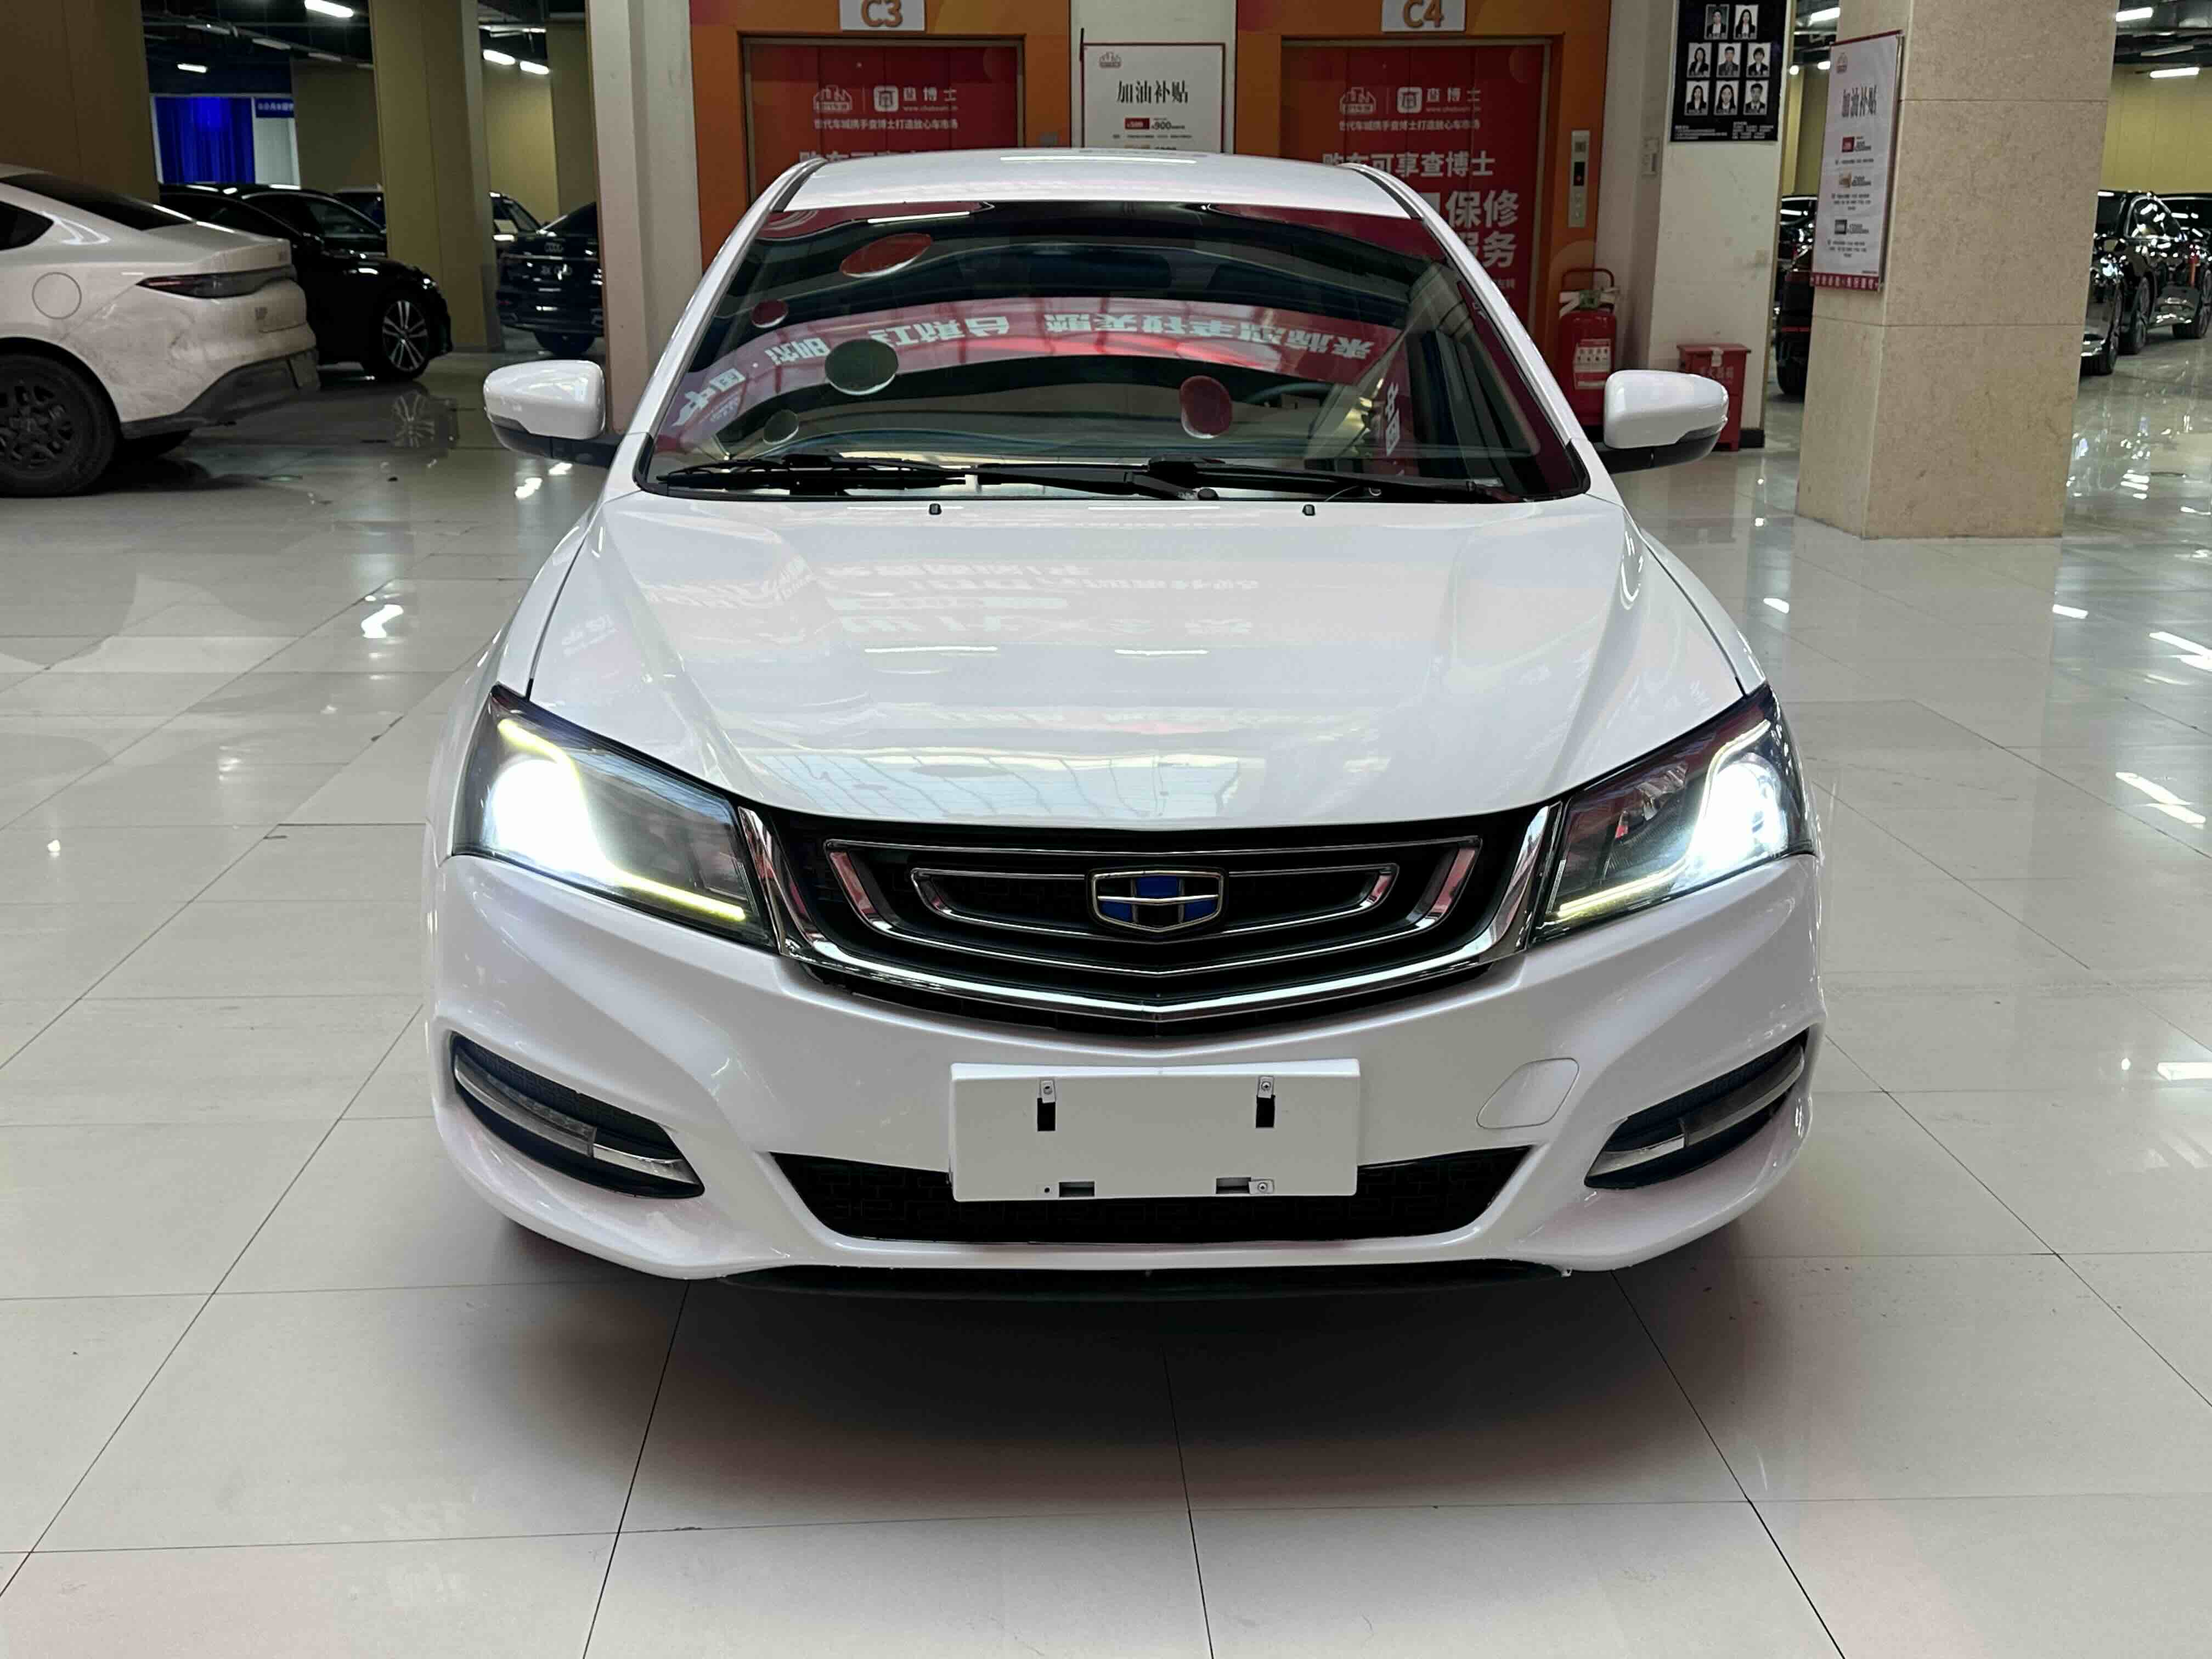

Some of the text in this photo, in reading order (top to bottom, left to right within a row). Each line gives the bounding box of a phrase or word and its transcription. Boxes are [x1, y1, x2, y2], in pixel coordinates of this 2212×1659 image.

[862, 0, 903, 27] C3
[1403, 0, 1444, 28] C4
[1116, 80, 1189, 104] 加油补贴
[1445, 190, 1519, 228] 保修
